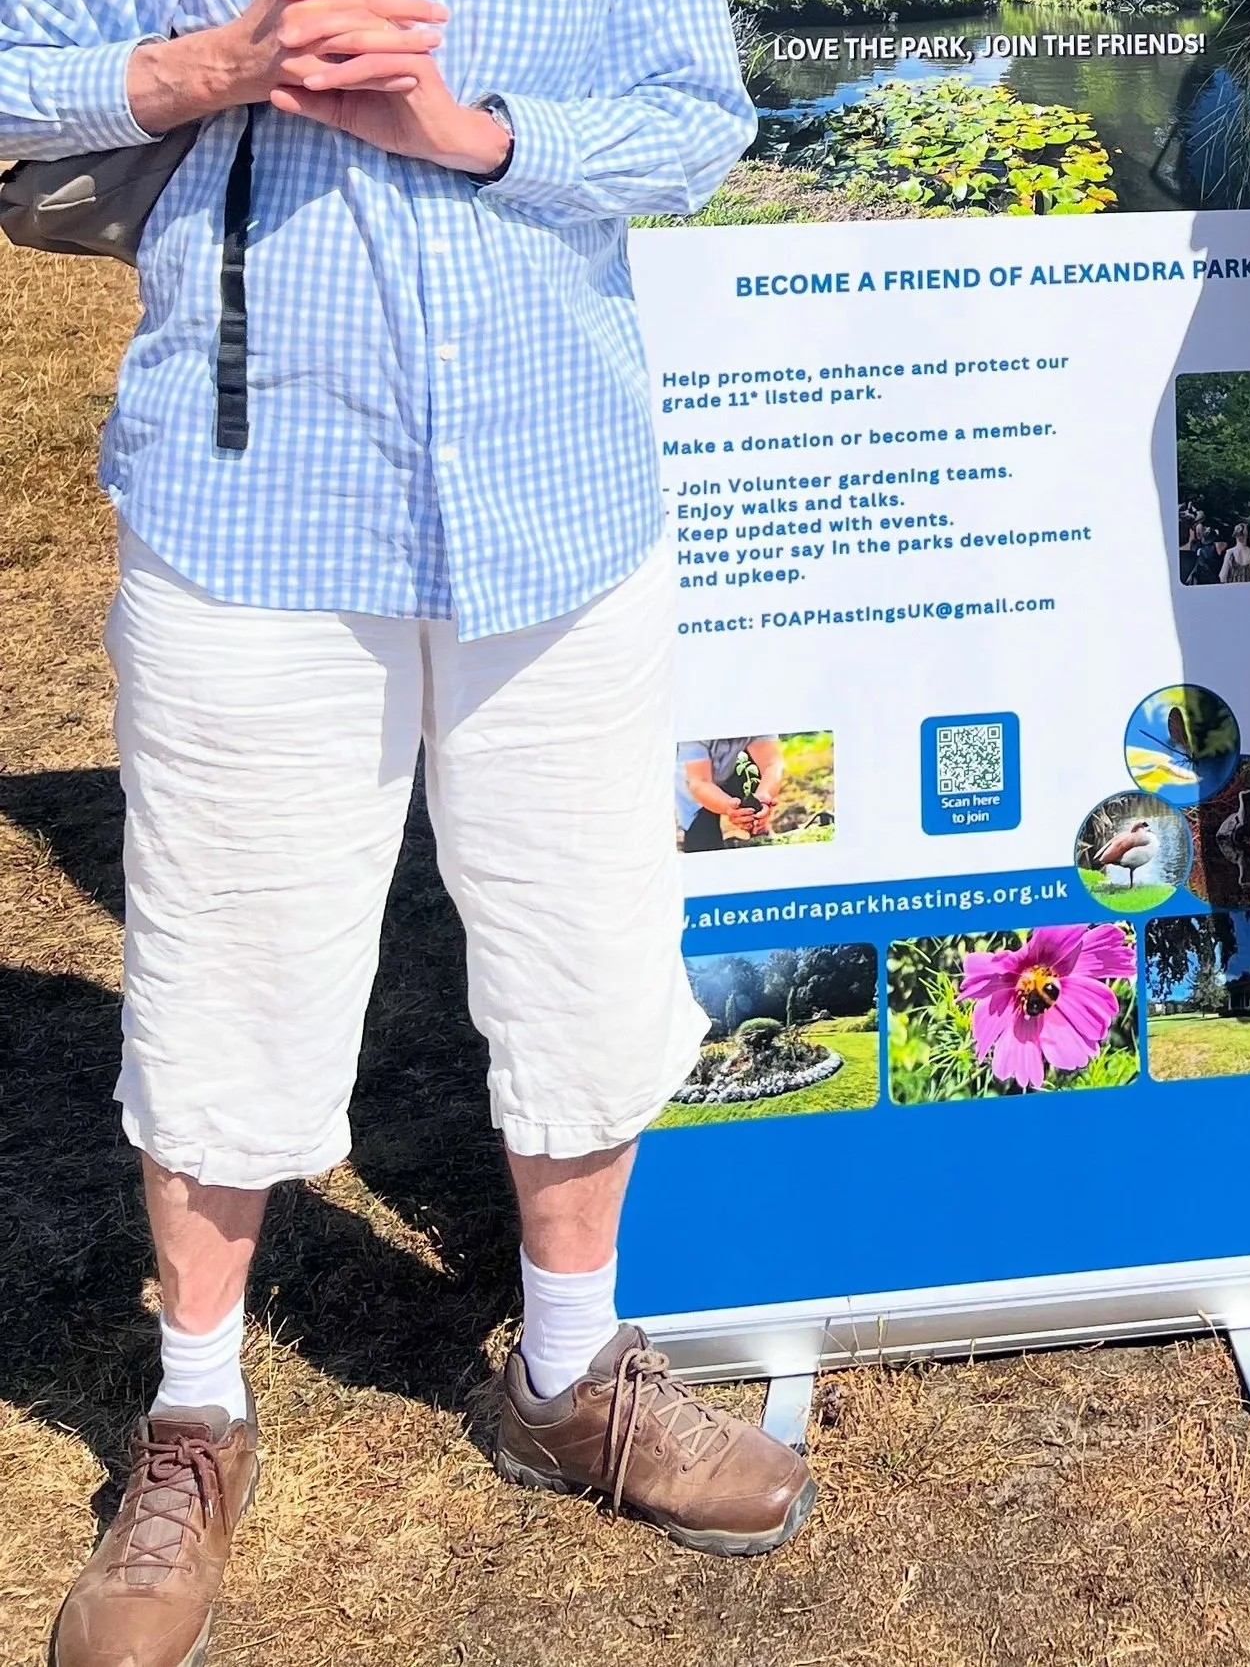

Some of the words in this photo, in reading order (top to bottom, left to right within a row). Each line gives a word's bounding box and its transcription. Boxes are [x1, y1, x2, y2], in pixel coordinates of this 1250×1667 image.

[774, 38, 838, 61] LOVE
[843, 37, 894, 59] THE
[901, 36, 973, 63] PARK,
[981, 35, 1038, 58] JOIN
[1042, 34, 1092, 56] THE
[1097, 33, 1205, 56] FRIENDS!
[736, 273, 850, 298] BECOME
[857, 271, 877, 292] A
[884, 267, 981, 291] FRIEND
[989, 266, 1023, 288] OF
[1030, 261, 1186, 286] ALEXANDRA
[662, 371, 711, 389] Help
[718, 367, 812, 388] promote,
[819, 363, 905, 380] enhance
[911, 360, 948, 376] and
[955, 356, 1030, 376] protect
[1036, 356, 1069, 370] our
[661, 393, 721, 413] grade
[765, 387, 823, 405] listed
[831, 385, 882, 404] park.
[662, 439, 716, 456] Make
[723, 440, 734, 453] a
[741, 433, 833, 451] donation
[841, 432, 862, 446] or
[869, 429, 948, 445] become
[955, 428, 966, 440] a
[973, 422, 1057, 439] member.
[677, 480, 721, 496] Join
[728, 475, 832, 493] Volunteer
[838, 468, 940, 490] gardening
[946, 465, 1013, 481] teams.
[677, 502, 734, 521] Enjoy
[742, 498, 798, 515] walks
[805, 494, 842, 511] and
[849, 492, 905, 509] talks.
[677, 527, 728, 543] Keep
[735, 518, 822, 541] updated
[829, 516, 873, 532] with
[879, 512, 954, 530] events.
[677, 550, 729, 565] Have
[736, 546, 783, 564] your
[790, 543, 825, 559] say
[832, 540, 850, 555] in
[857, 537, 891, 553] the
[898, 534, 953, 554] parks
[960, 526, 1092, 547] development
[679, 571, 718, 588] and
[725, 568, 806, 587] upkeep.
[677, 615, 753, 634] ontact:
[761, 597, 1056, 629] FOAPHastingsUK@gmail.com
[941, 797, 970, 809] Scan
[973, 794, 1000, 806] here
[952, 813, 965, 824] to
[966, 810, 990, 825] join
